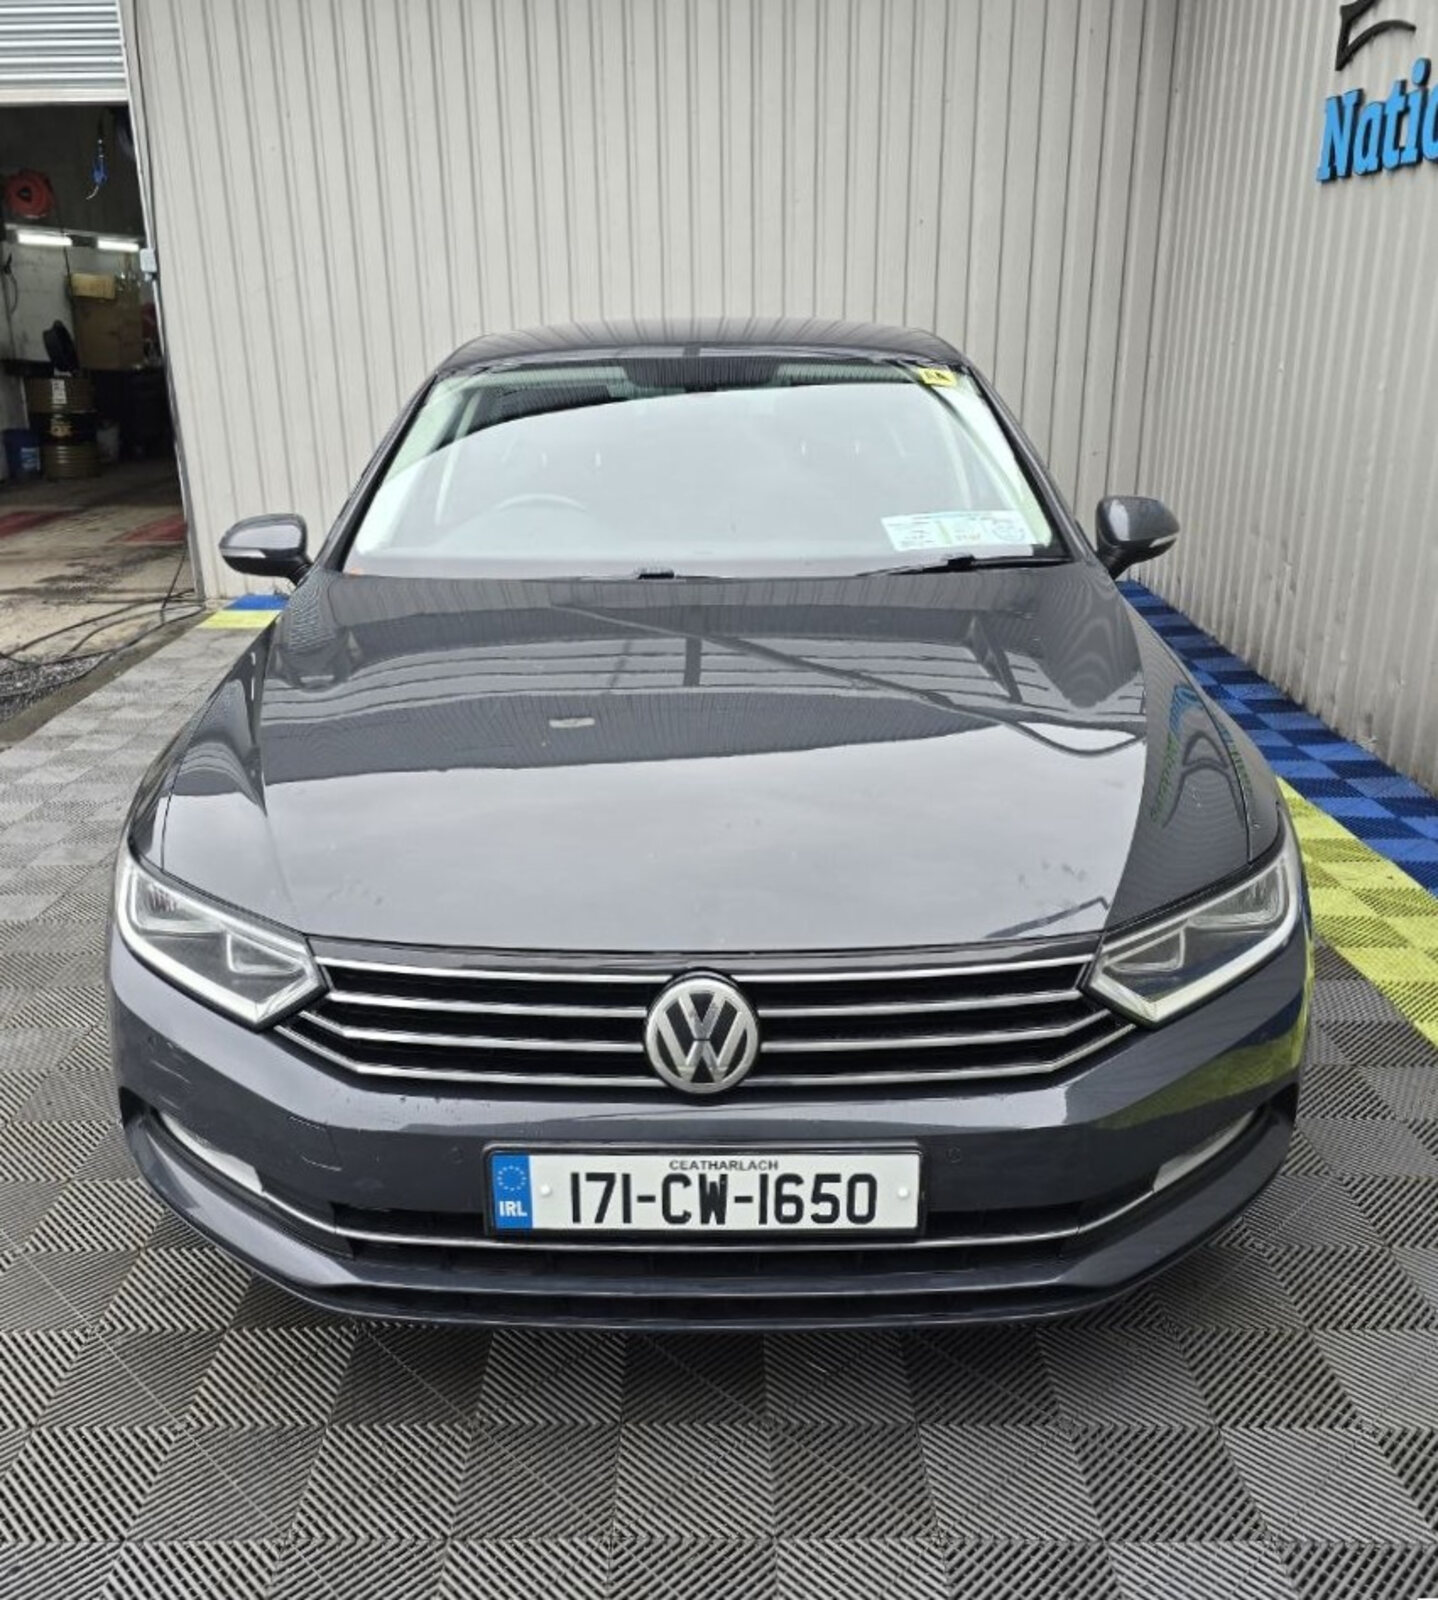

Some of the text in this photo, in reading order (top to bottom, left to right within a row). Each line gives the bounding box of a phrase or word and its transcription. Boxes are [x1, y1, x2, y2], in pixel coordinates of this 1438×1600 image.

[652, 983, 750, 1087] VW
[668, 1159, 779, 1171] CEATHARLACH
[500, 1201, 528, 1219] IRL
[569, 1172, 878, 1225] 171-CW-1650
